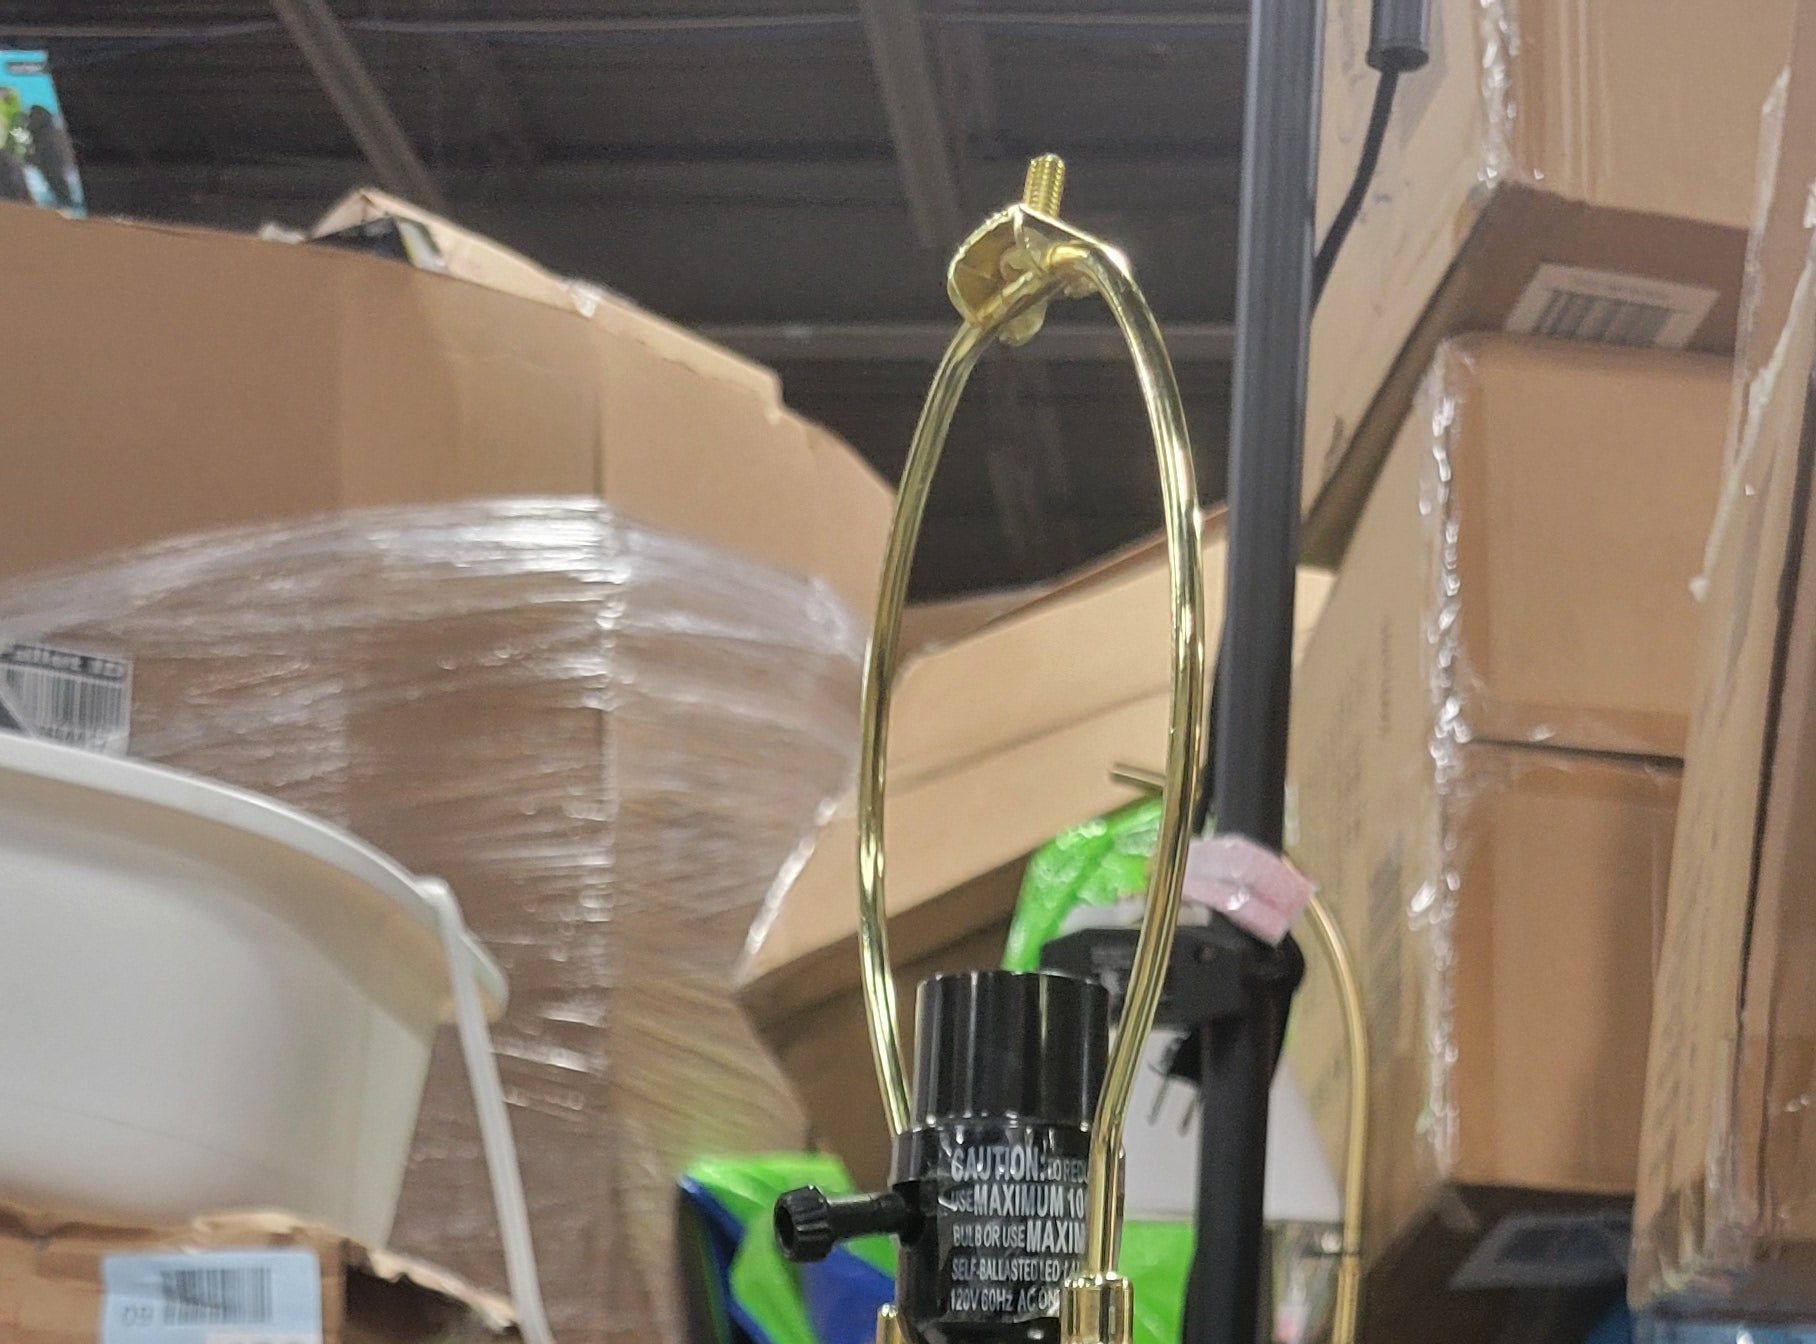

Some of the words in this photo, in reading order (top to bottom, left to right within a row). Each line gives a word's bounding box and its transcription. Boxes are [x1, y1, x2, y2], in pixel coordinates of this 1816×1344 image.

[951, 1144, 1046, 1183] CAUTION:
[951, 1189, 973, 1213] USE
[974, 1182, 1064, 1219] MAXIMUM
[953, 1223, 982, 1247] BULB
[983, 1223, 1000, 1249] OR
[1002, 1224, 1026, 1249] USE
[951, 1256, 1037, 1282] SELF-BALLASTED
[1039, 1258, 1060, 1282] LED
[950, 1287, 979, 1312] 120V
[981, 1287, 1014, 1312] 60Hz
[1017, 1287, 1037, 1313] AC
